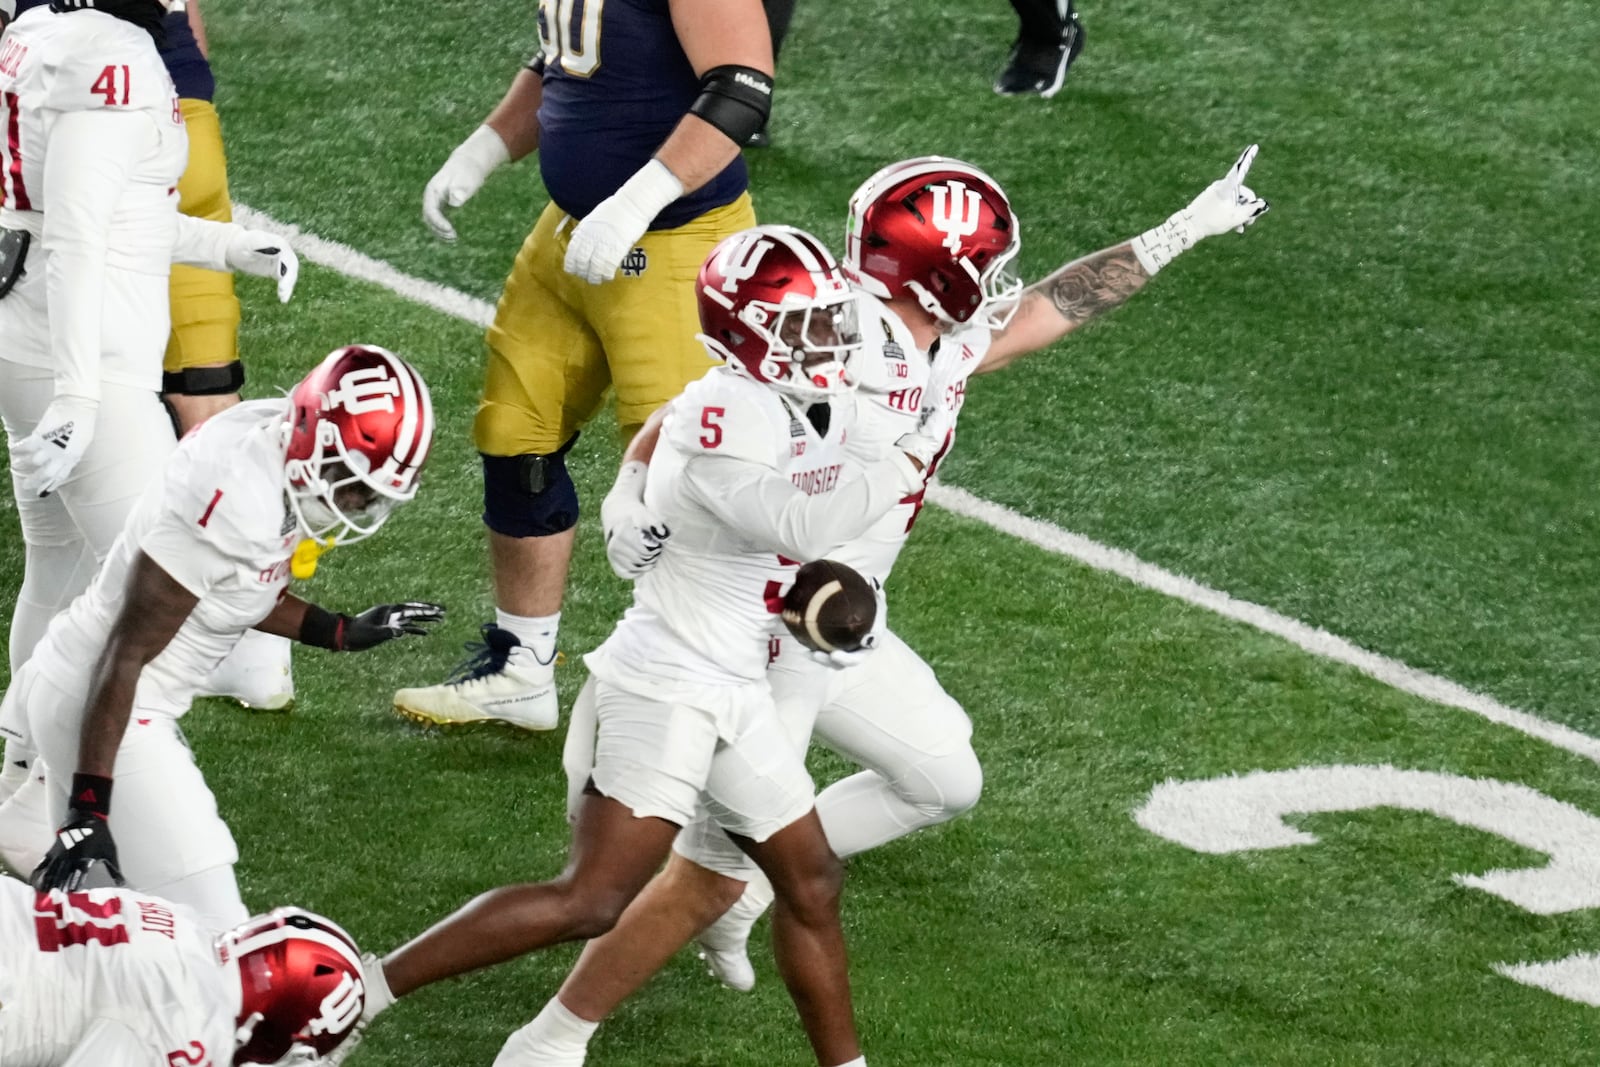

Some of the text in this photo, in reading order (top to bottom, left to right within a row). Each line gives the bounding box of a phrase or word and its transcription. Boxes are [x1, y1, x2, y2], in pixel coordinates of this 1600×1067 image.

[90, 65, 130, 106] 41
[930, 181, 983, 248] IU
[718, 232, 775, 293] IU
[328, 365, 400, 416] IU
[700, 406, 726, 448] 5
[197, 489, 224, 528] 1
